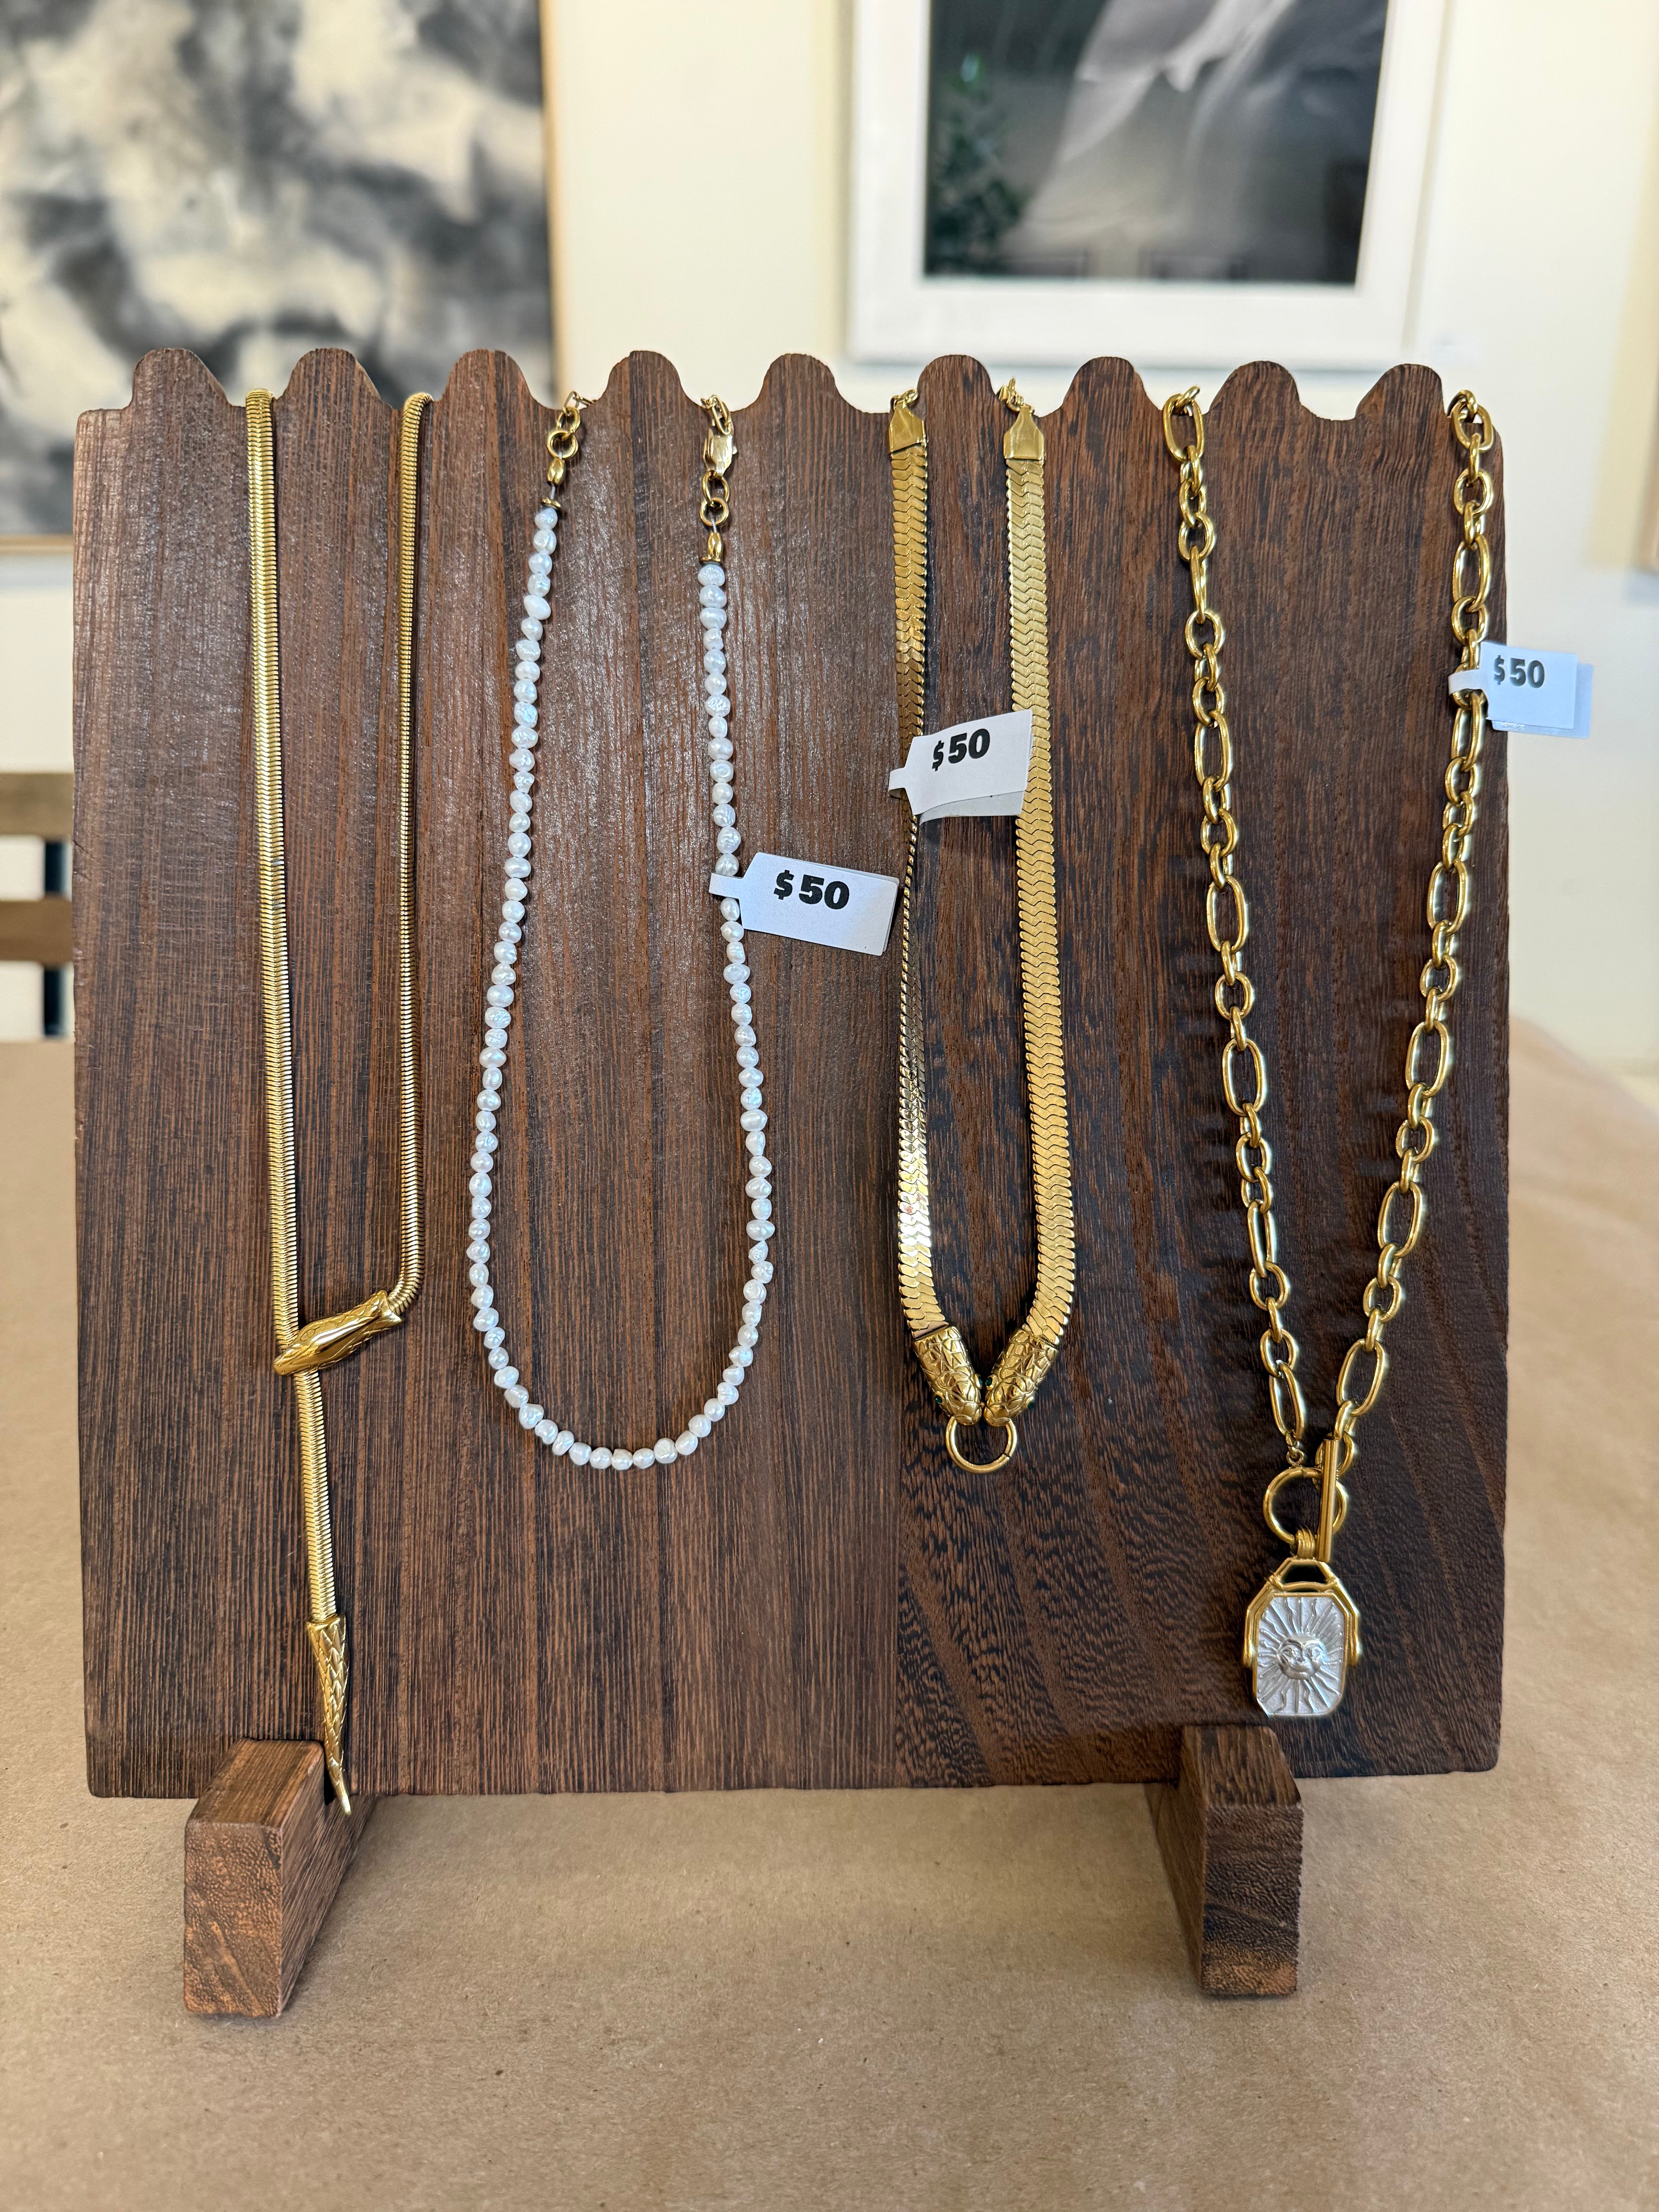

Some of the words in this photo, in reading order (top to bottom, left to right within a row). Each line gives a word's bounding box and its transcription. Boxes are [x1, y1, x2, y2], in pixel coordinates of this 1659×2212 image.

[1494, 655, 1545, 689] $50
[932, 728, 990, 772] $50
[773, 870, 850, 910] $50
